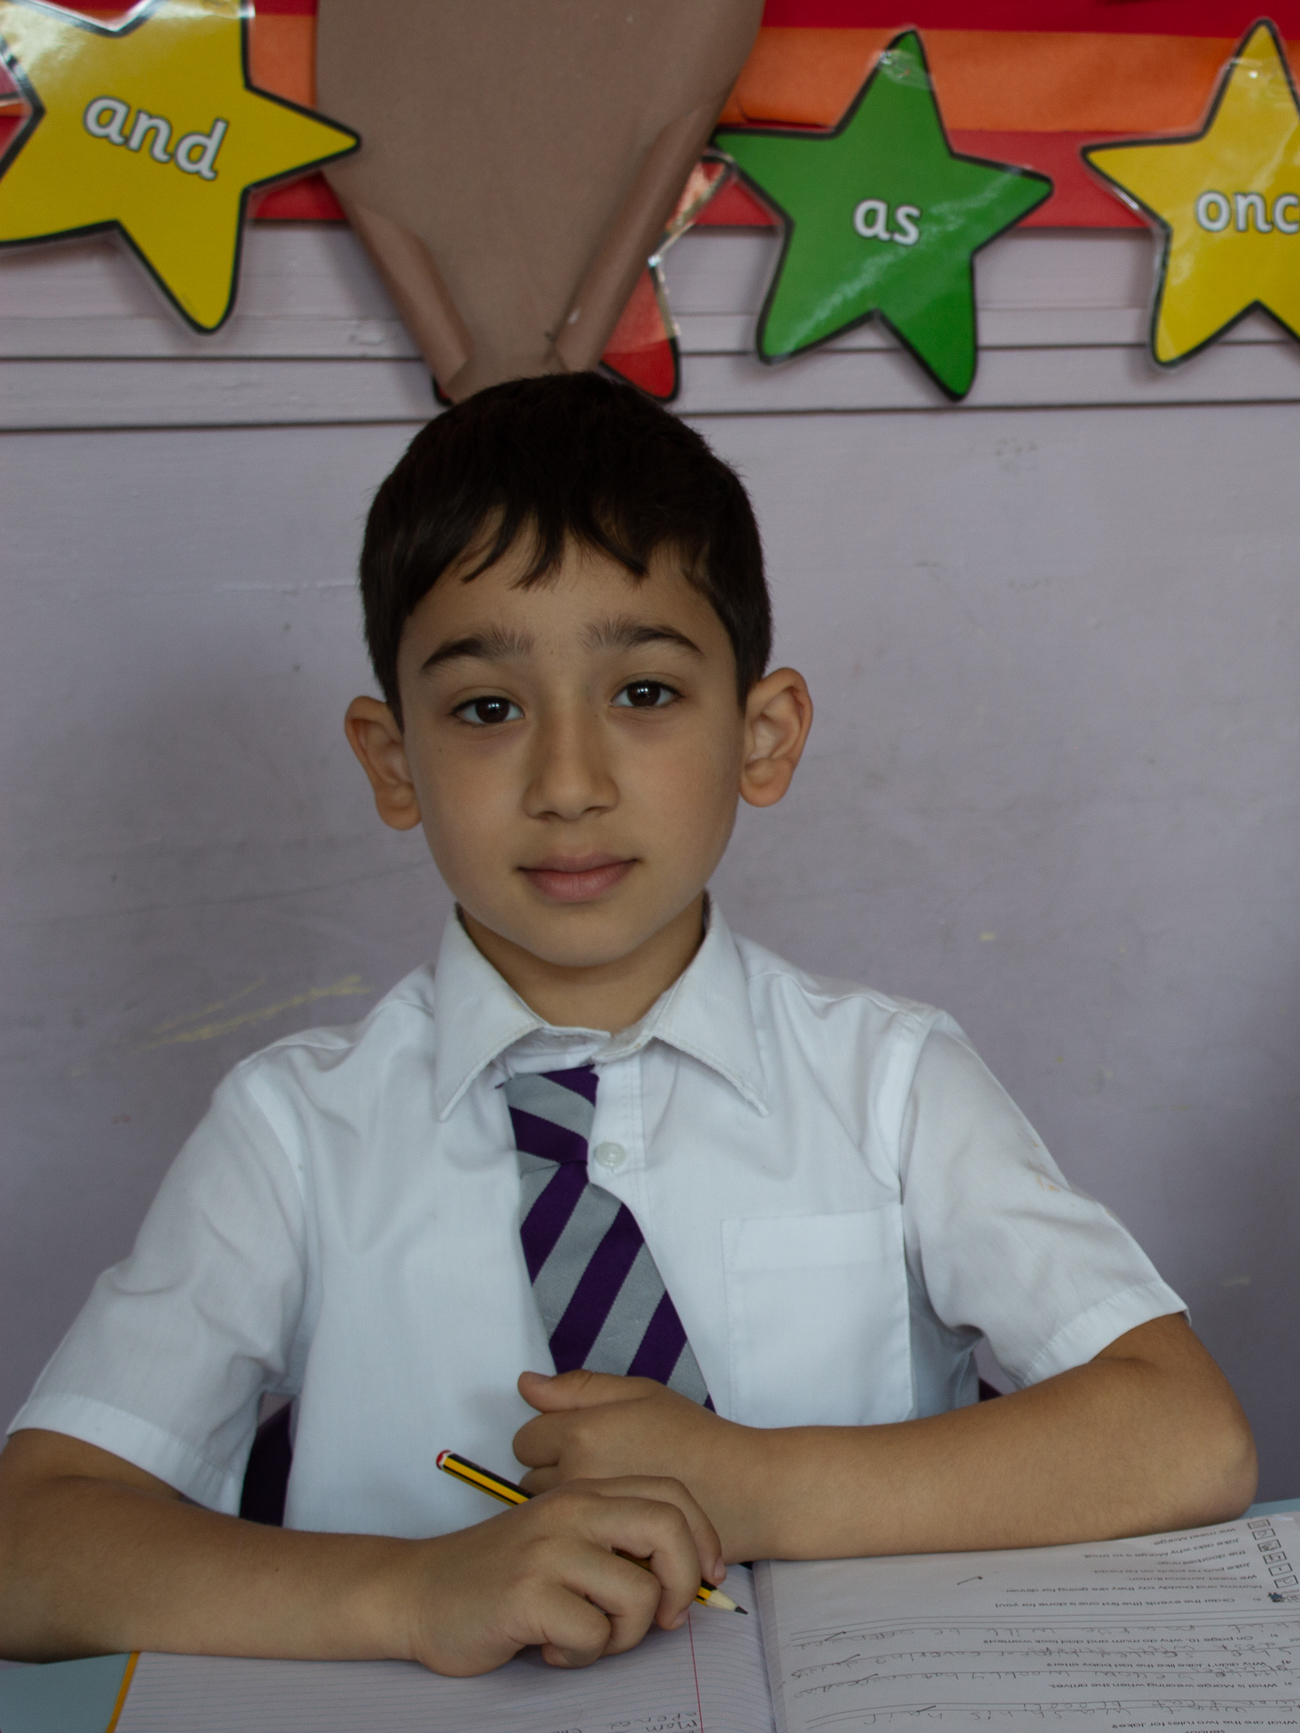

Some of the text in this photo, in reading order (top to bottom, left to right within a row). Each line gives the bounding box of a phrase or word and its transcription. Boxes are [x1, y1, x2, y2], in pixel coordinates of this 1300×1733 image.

[84, 95, 230, 181] and
[854, 199, 921, 246] as
[1216, 1537, 1238, 1546] Jake
